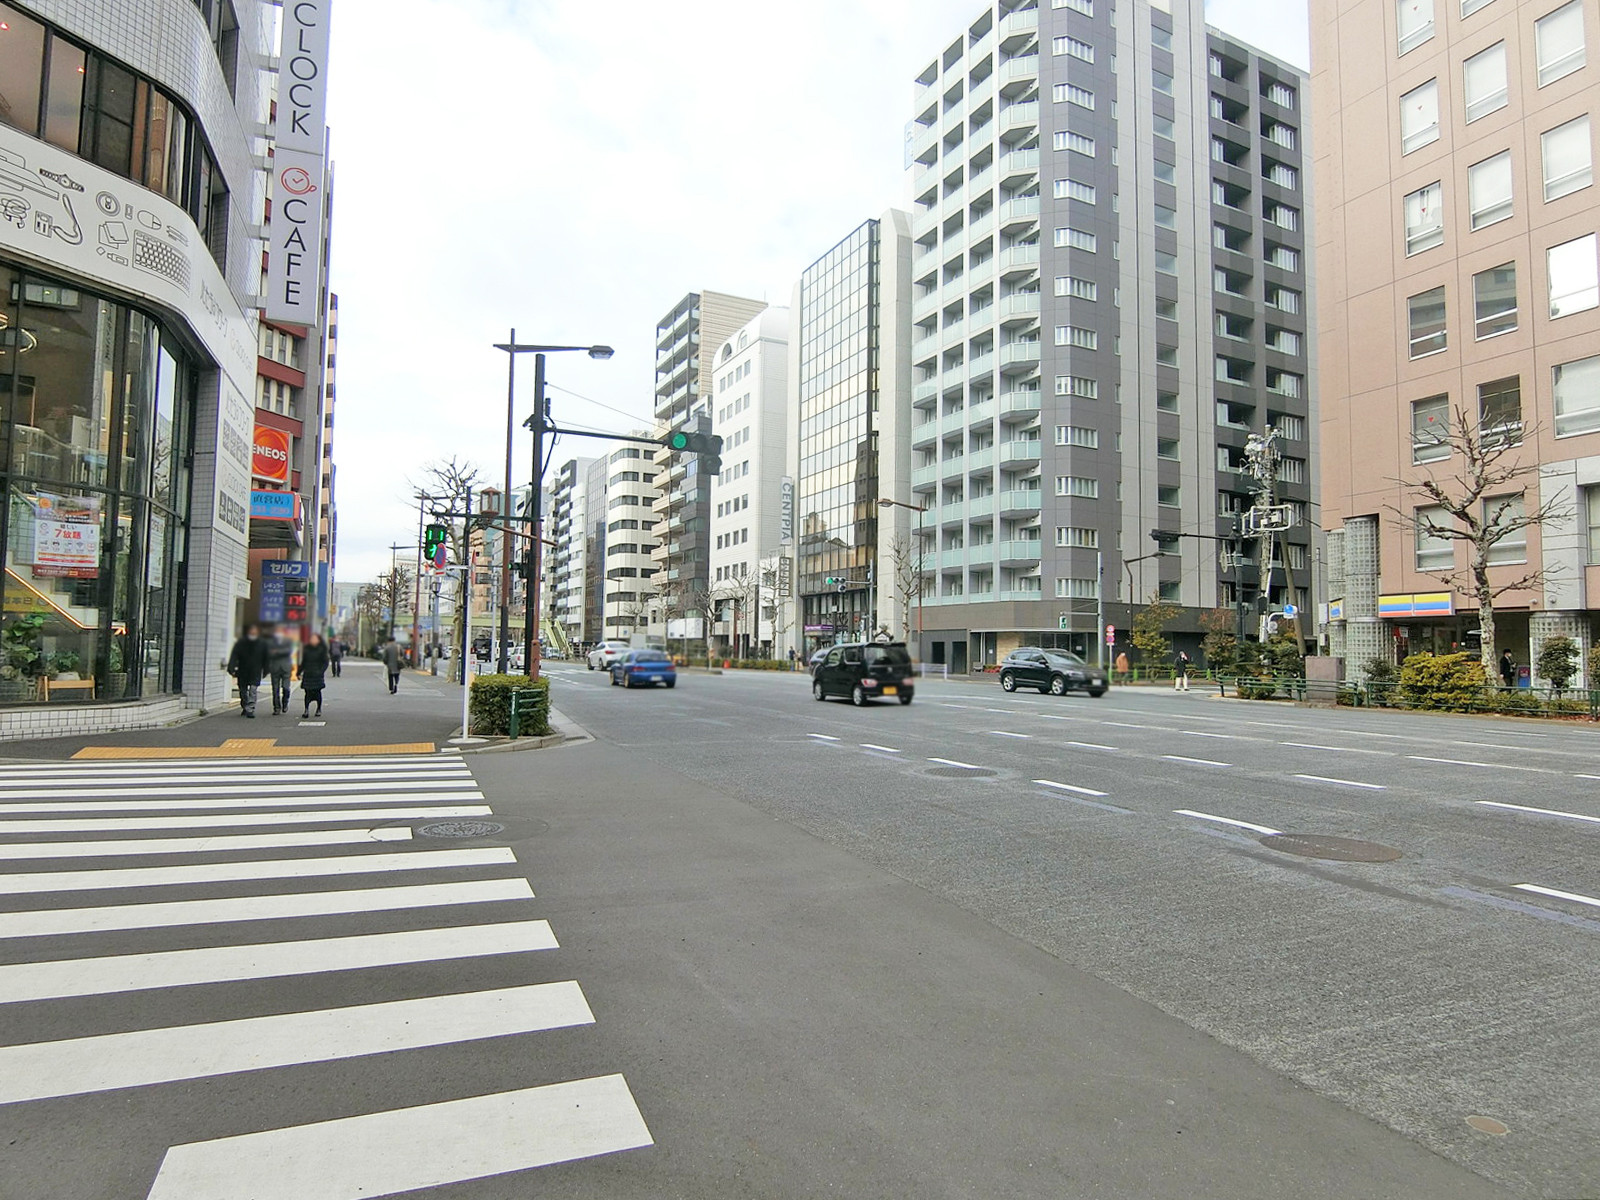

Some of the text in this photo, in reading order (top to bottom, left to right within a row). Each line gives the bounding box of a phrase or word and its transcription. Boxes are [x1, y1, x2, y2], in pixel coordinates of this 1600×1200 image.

[289, 2, 317, 136] CLOCK
[284, 199, 309, 306] CAFE
[782, 483, 791, 540] CENTPIA
[270, 563, 302, 574] セルフ
[288, 595, 306, 606] 175
